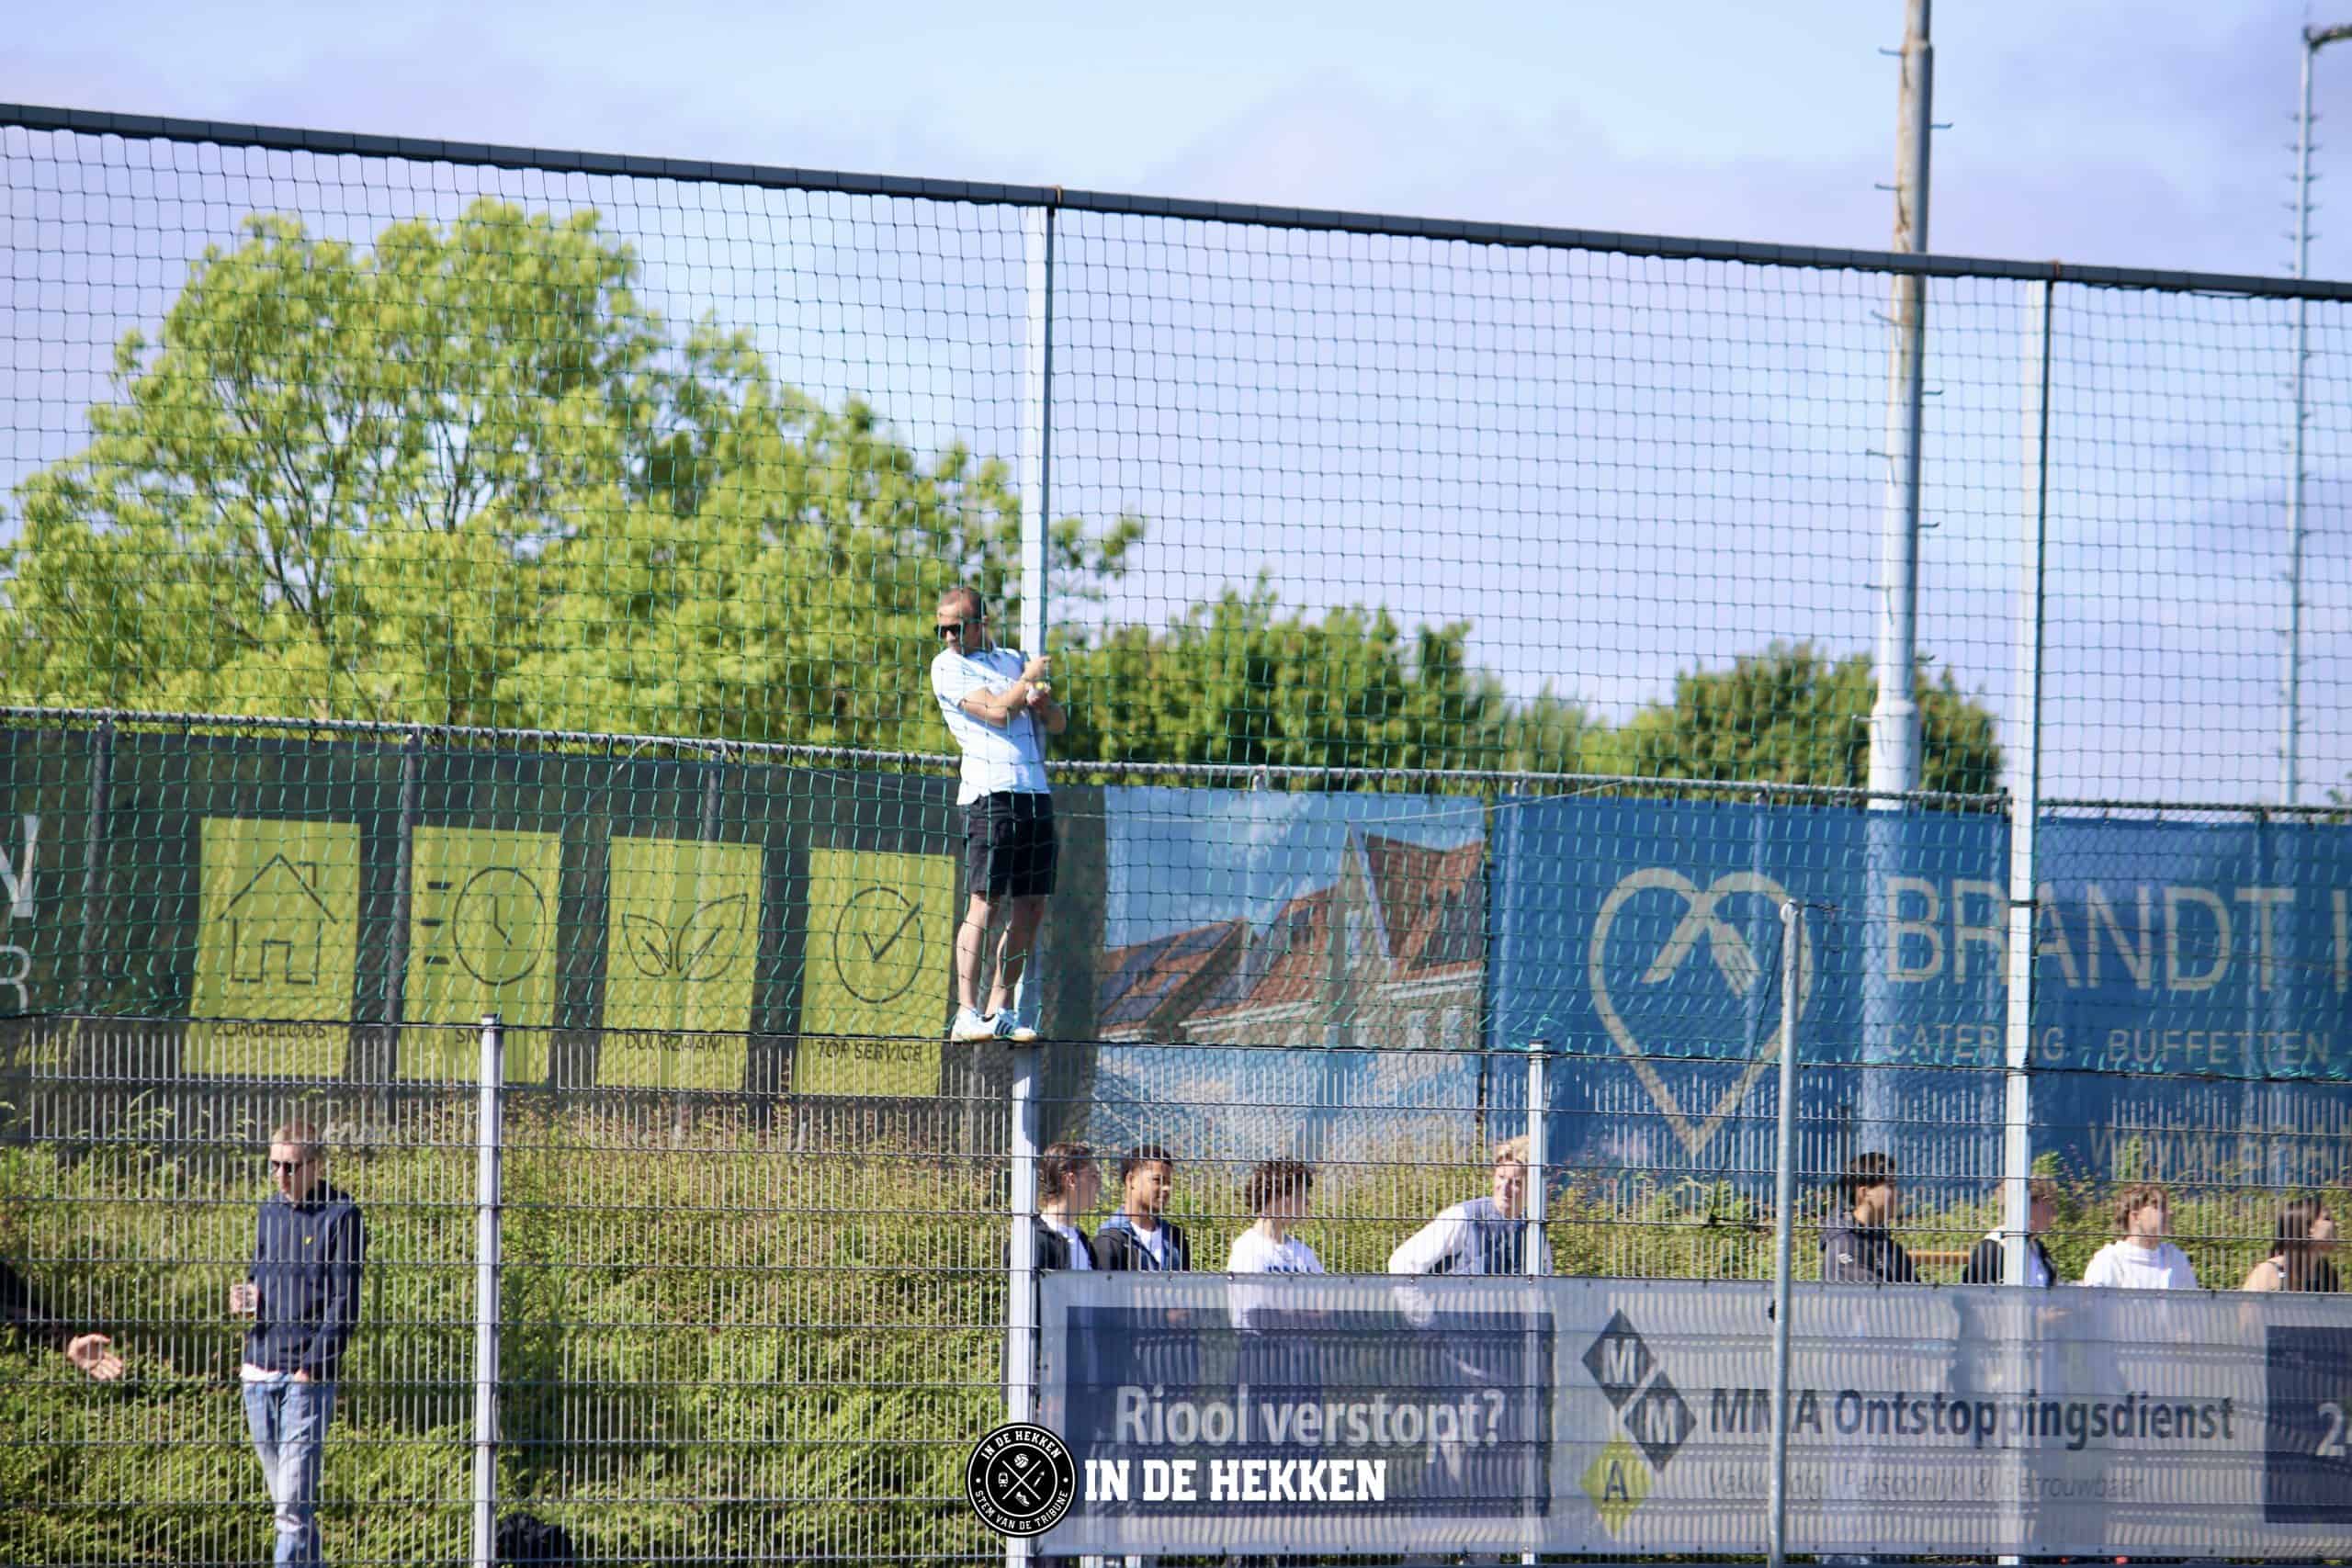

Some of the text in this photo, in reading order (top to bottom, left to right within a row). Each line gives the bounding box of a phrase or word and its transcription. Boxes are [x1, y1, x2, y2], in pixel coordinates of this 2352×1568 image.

[1885, 875, 2295, 993] BRANDT
[212, 1022, 326, 1039] ZORGELOOS
[625, 1033, 723, 1053] DUURZAAM
[817, 1041, 922, 1063] TOP SERVICE
[1884, 1022, 2331, 1066] CATERG BUFFETTEN
[1115, 1382, 1507, 1465] Riool verstopt?
[1835, 1388, 2234, 1450] Ontstoppingsdienst
